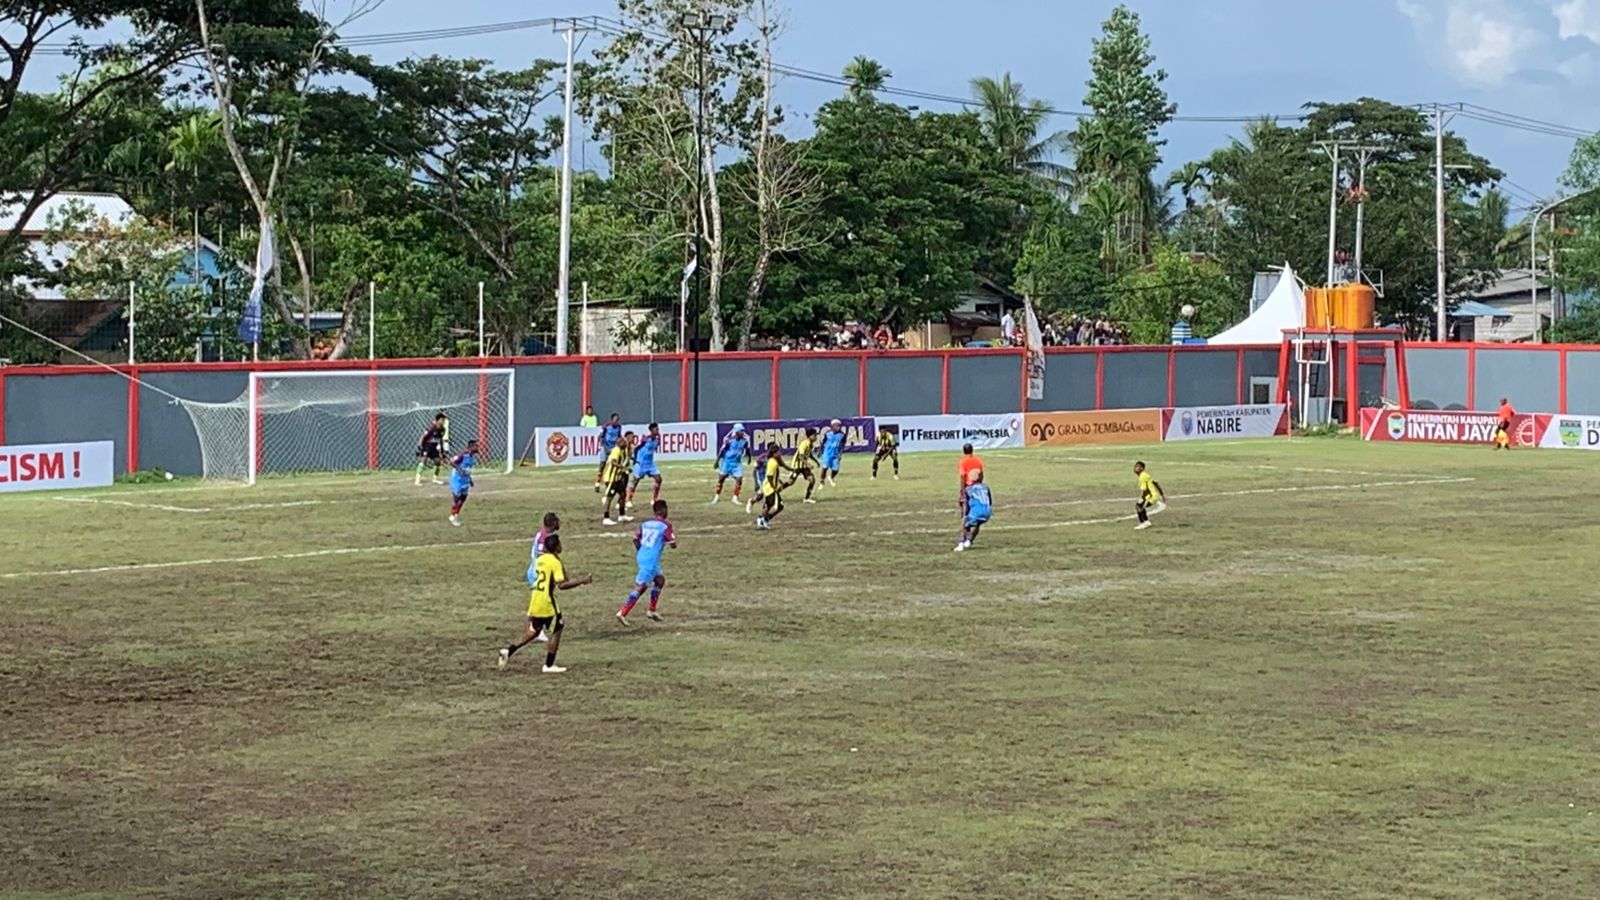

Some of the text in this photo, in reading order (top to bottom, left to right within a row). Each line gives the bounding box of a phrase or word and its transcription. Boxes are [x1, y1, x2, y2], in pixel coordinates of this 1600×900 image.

[1197, 407, 1271, 418] PEMERINTAH KABUPATEN
[1407, 414, 1459, 424] PEMERINTAH
[1058, 421, 1155, 436] GRAND TEMBAGA HOTEL
[1197, 418, 1242, 434] NABIRE
[1407, 423, 1458, 440] INTAN
[753, 425, 870, 450] PENTAOAL
[902, 428, 1010, 441] PT FREEPORT INDONESIA
